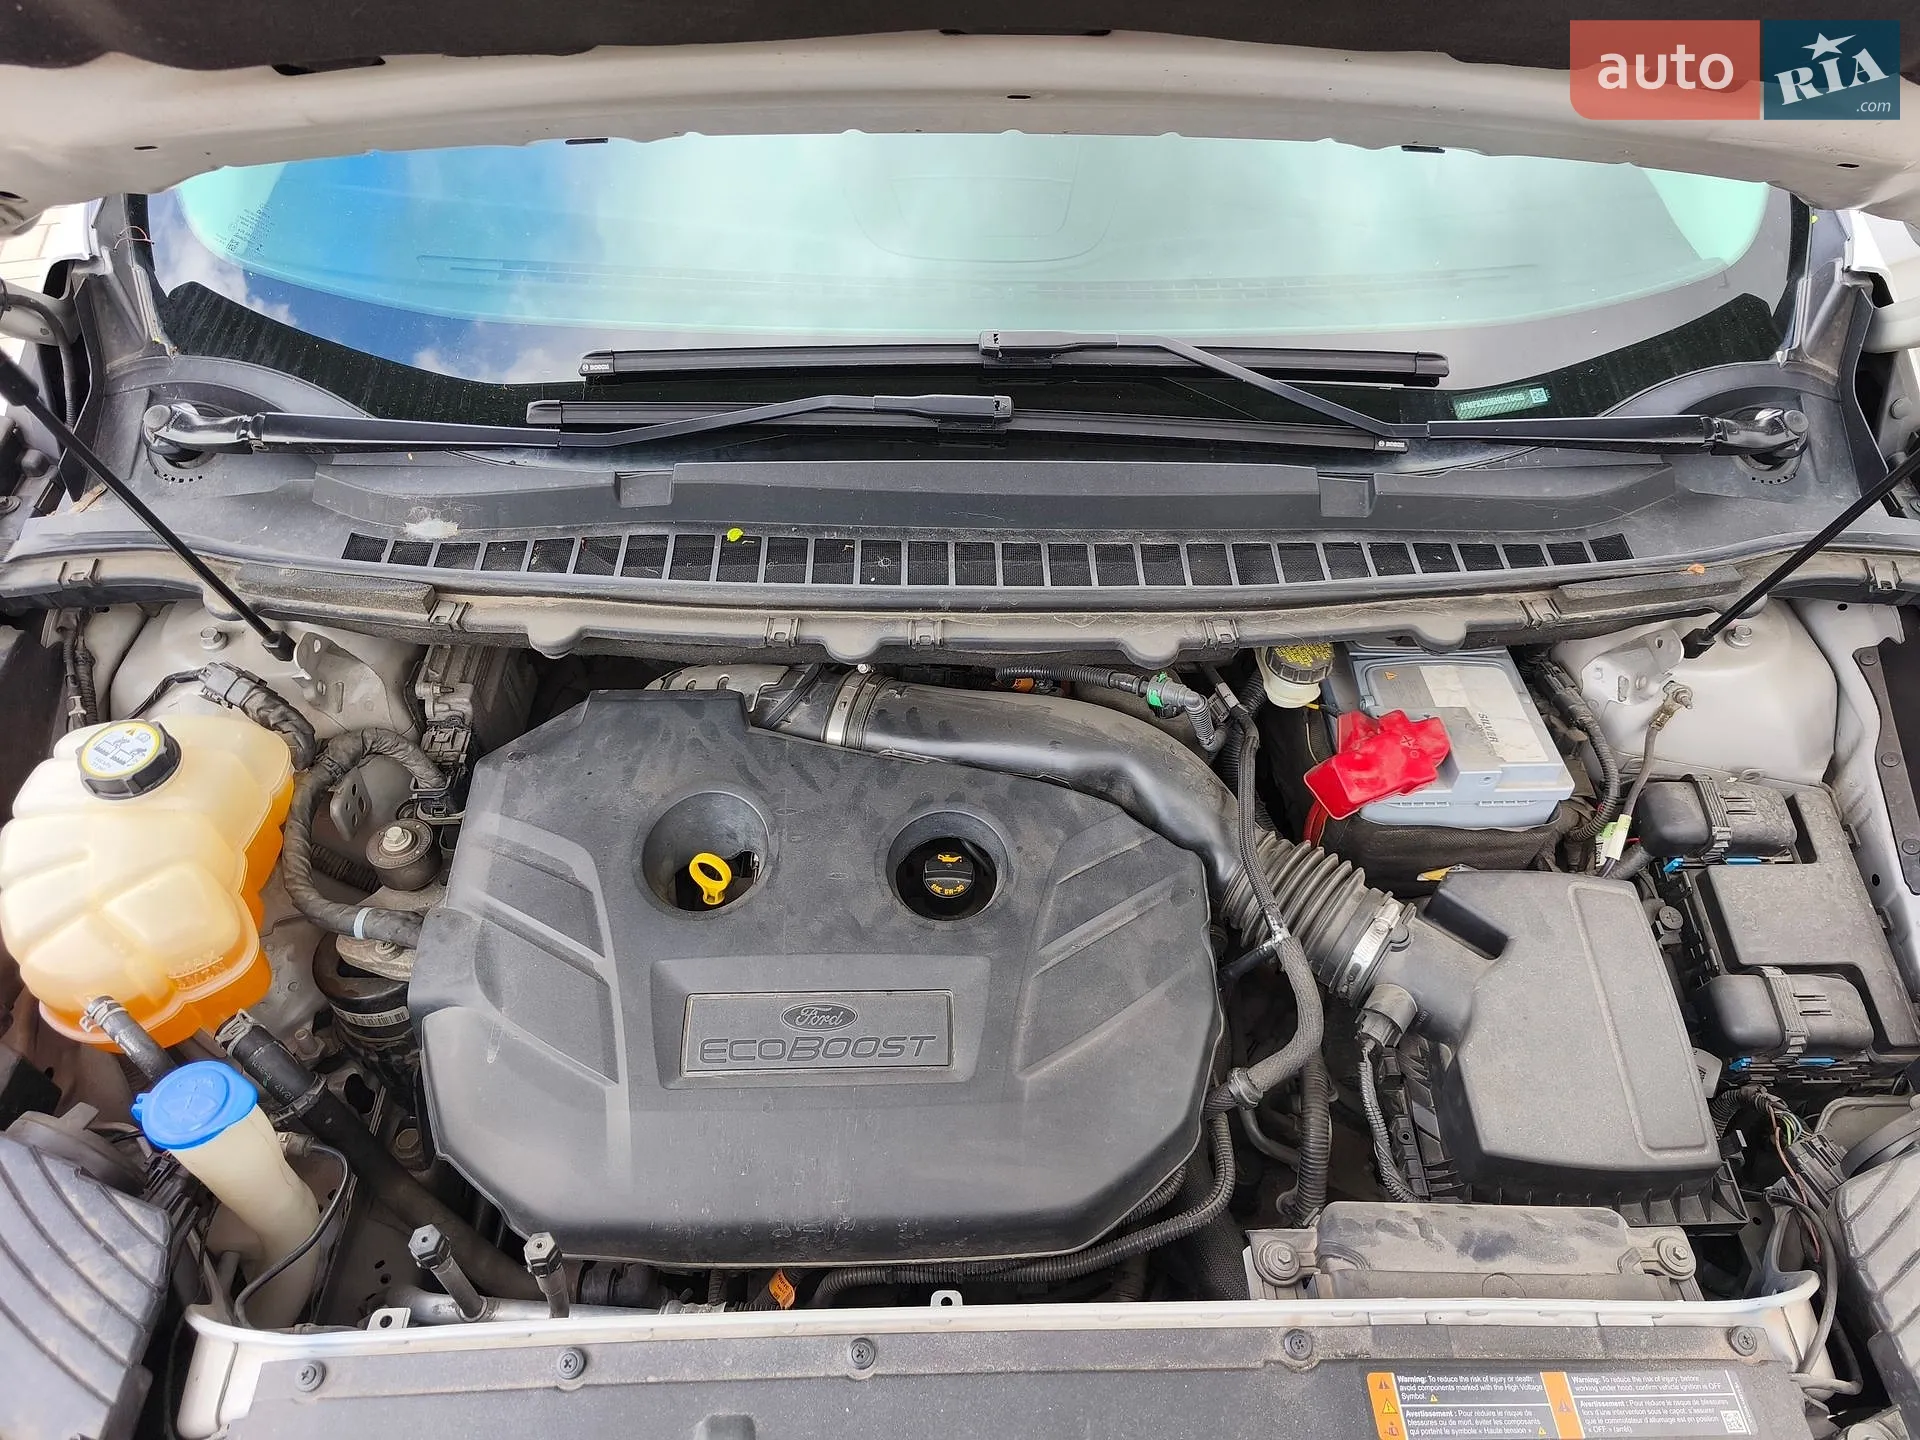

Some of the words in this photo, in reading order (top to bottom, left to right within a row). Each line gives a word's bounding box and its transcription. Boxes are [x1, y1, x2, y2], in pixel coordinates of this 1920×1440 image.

[796, 1006, 844, 1026] Ford
[1397, 1375, 1427, 1385] Warning:
[1437, 1375, 1458, 1383] reduce
[1470, 1375, 1481, 1383] risk
[1490, 1375, 1506, 1384] injury
[1571, 1375, 1600, 1385] Warning:
[1610, 1375, 1632, 1383] reduce
[1418, 1384, 1455, 1393] components
[1505, 1384, 1519, 1392] High
[1519, 1384, 1544, 1392] Voltage
